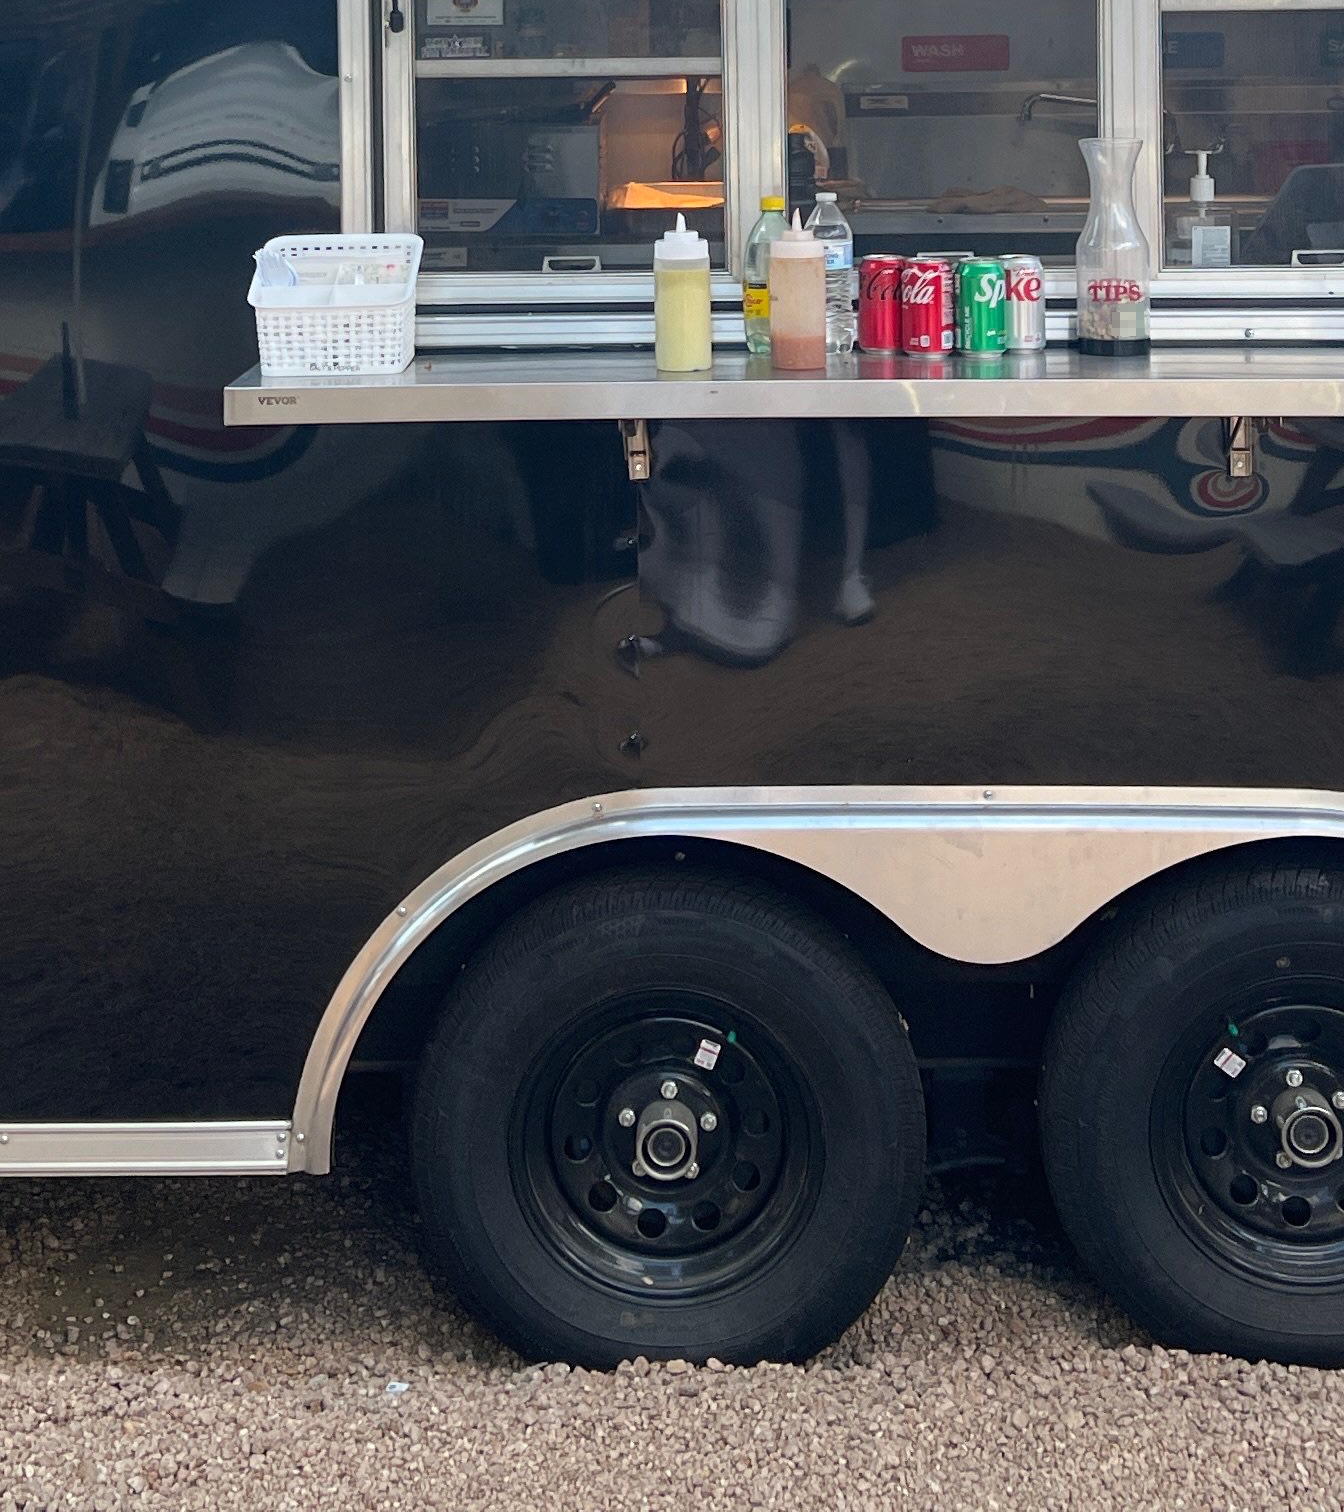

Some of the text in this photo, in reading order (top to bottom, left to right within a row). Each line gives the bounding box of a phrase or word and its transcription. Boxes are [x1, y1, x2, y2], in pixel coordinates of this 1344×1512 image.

[912, 44, 966, 56] WASH
[1005, 270, 1041, 301] ke
[1088, 283, 1143, 302] TIPS
[258, 397, 297, 405] VEVOR
